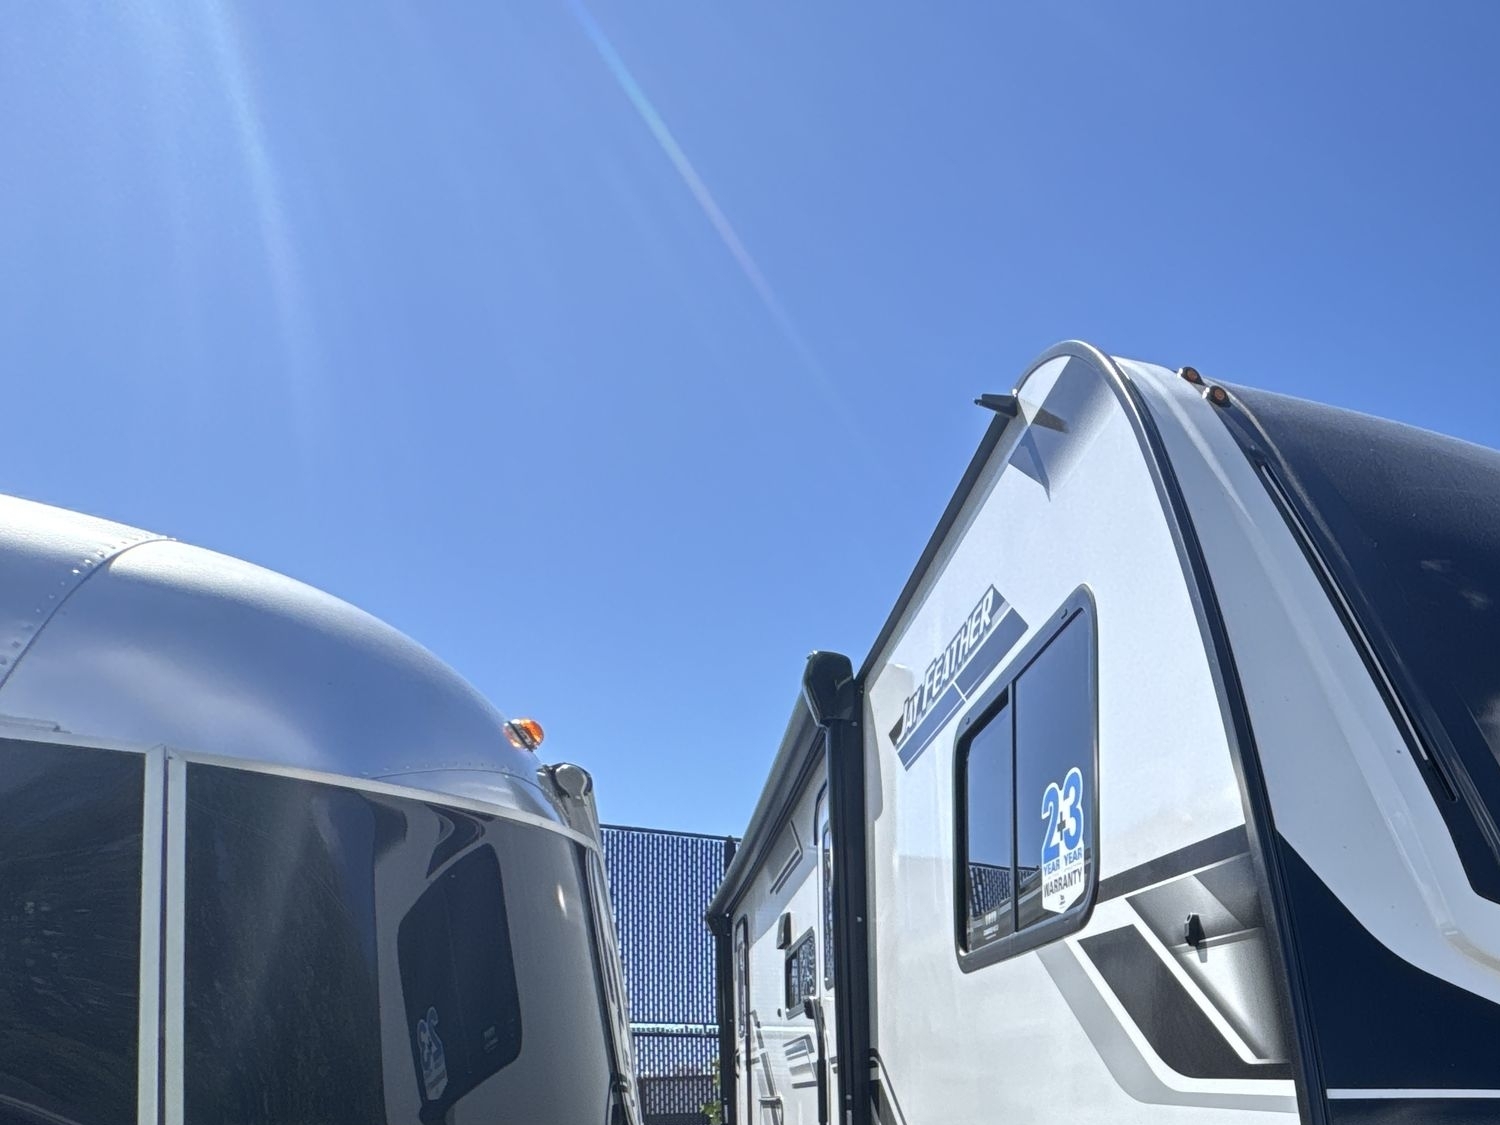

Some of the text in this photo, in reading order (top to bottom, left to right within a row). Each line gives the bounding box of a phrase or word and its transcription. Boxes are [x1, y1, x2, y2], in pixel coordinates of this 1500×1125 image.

[922, 588, 994, 710] FEATHER
[1044, 848, 1083, 877] YEAR YEAR
[1044, 868, 1083, 898] WARRANTY
